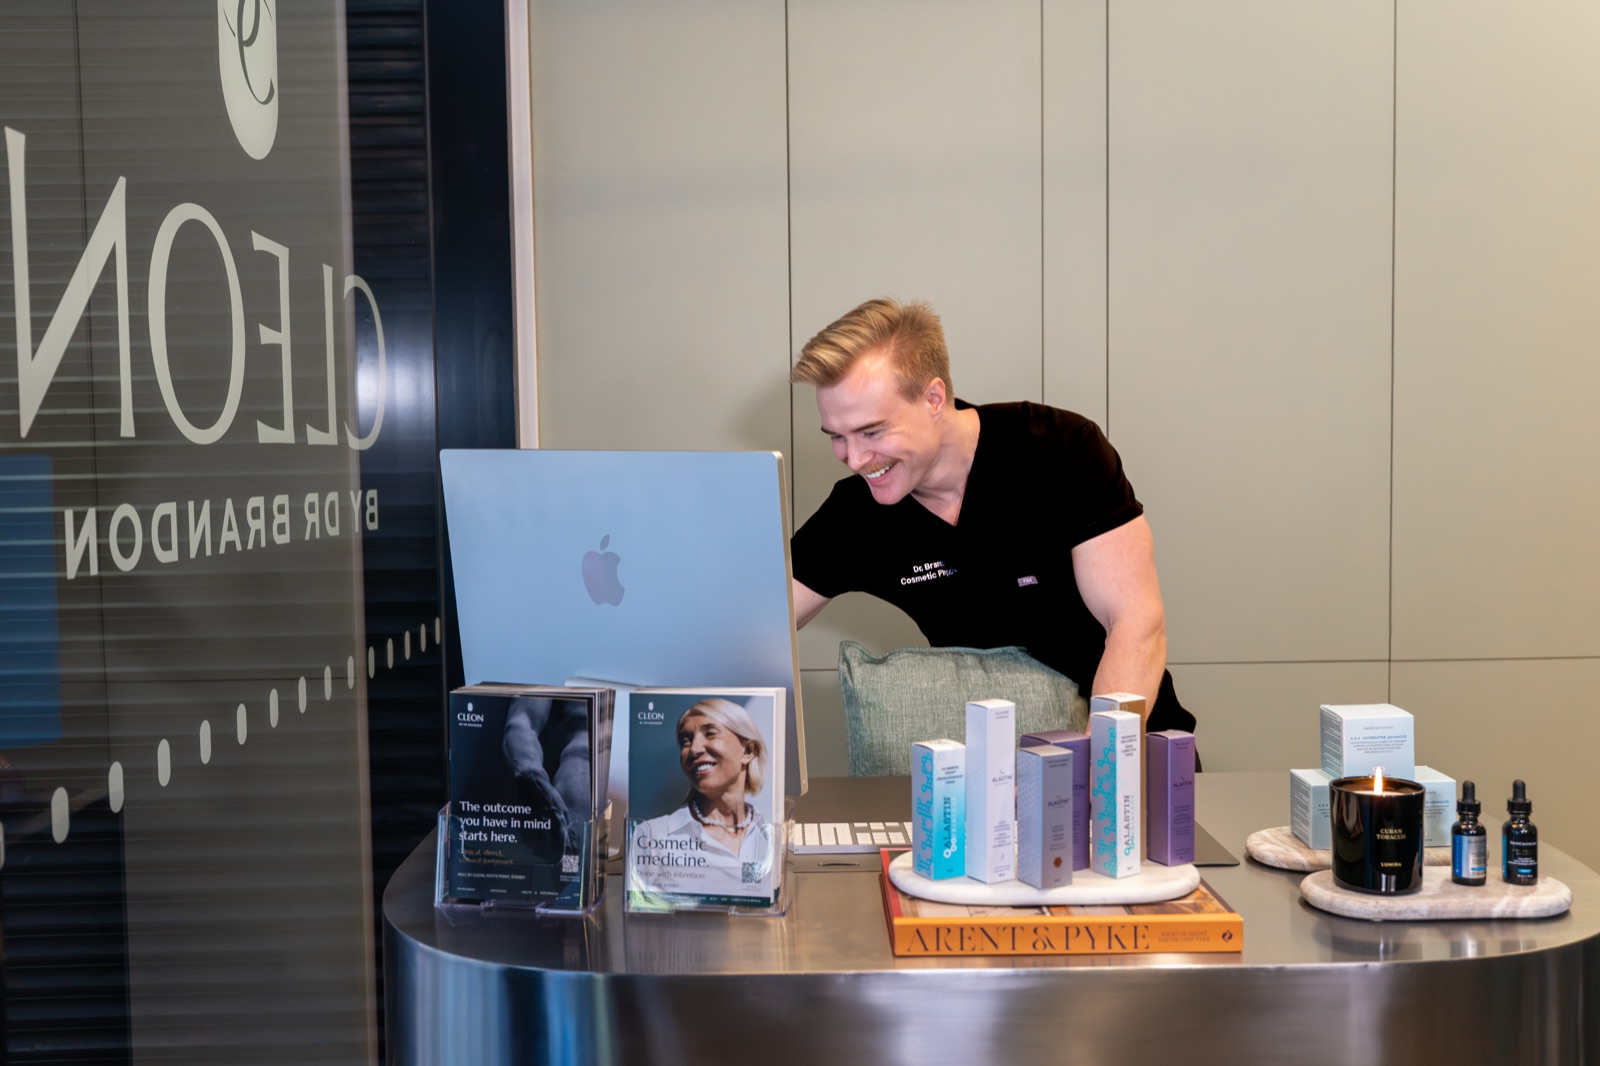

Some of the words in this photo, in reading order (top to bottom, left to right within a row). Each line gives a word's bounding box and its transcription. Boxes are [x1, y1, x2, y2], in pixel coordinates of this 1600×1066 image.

[900, 571, 937, 585] Cosmetic
[457, 712, 484, 722] CLEON
[637, 711, 665, 720] CLEON
[459, 801, 480, 813] The
[483, 804, 532, 815] outcome
[459, 817, 480, 828] you
[483, 817, 508, 828] have
[510, 817, 521, 828] in
[523, 818, 551, 830] mind
[943, 797, 951, 849] ALASTIN
[458, 831, 488, 842] starts
[490, 832, 518, 843] here.
[637, 835, 707, 851] Cosmetic
[637, 852, 709, 868] medicine.
[656, 870, 672, 878] with
[907, 926, 1025, 952] ARENT
[1031, 925, 1056, 951] &
[1063, 925, 1150, 950] PYKE
